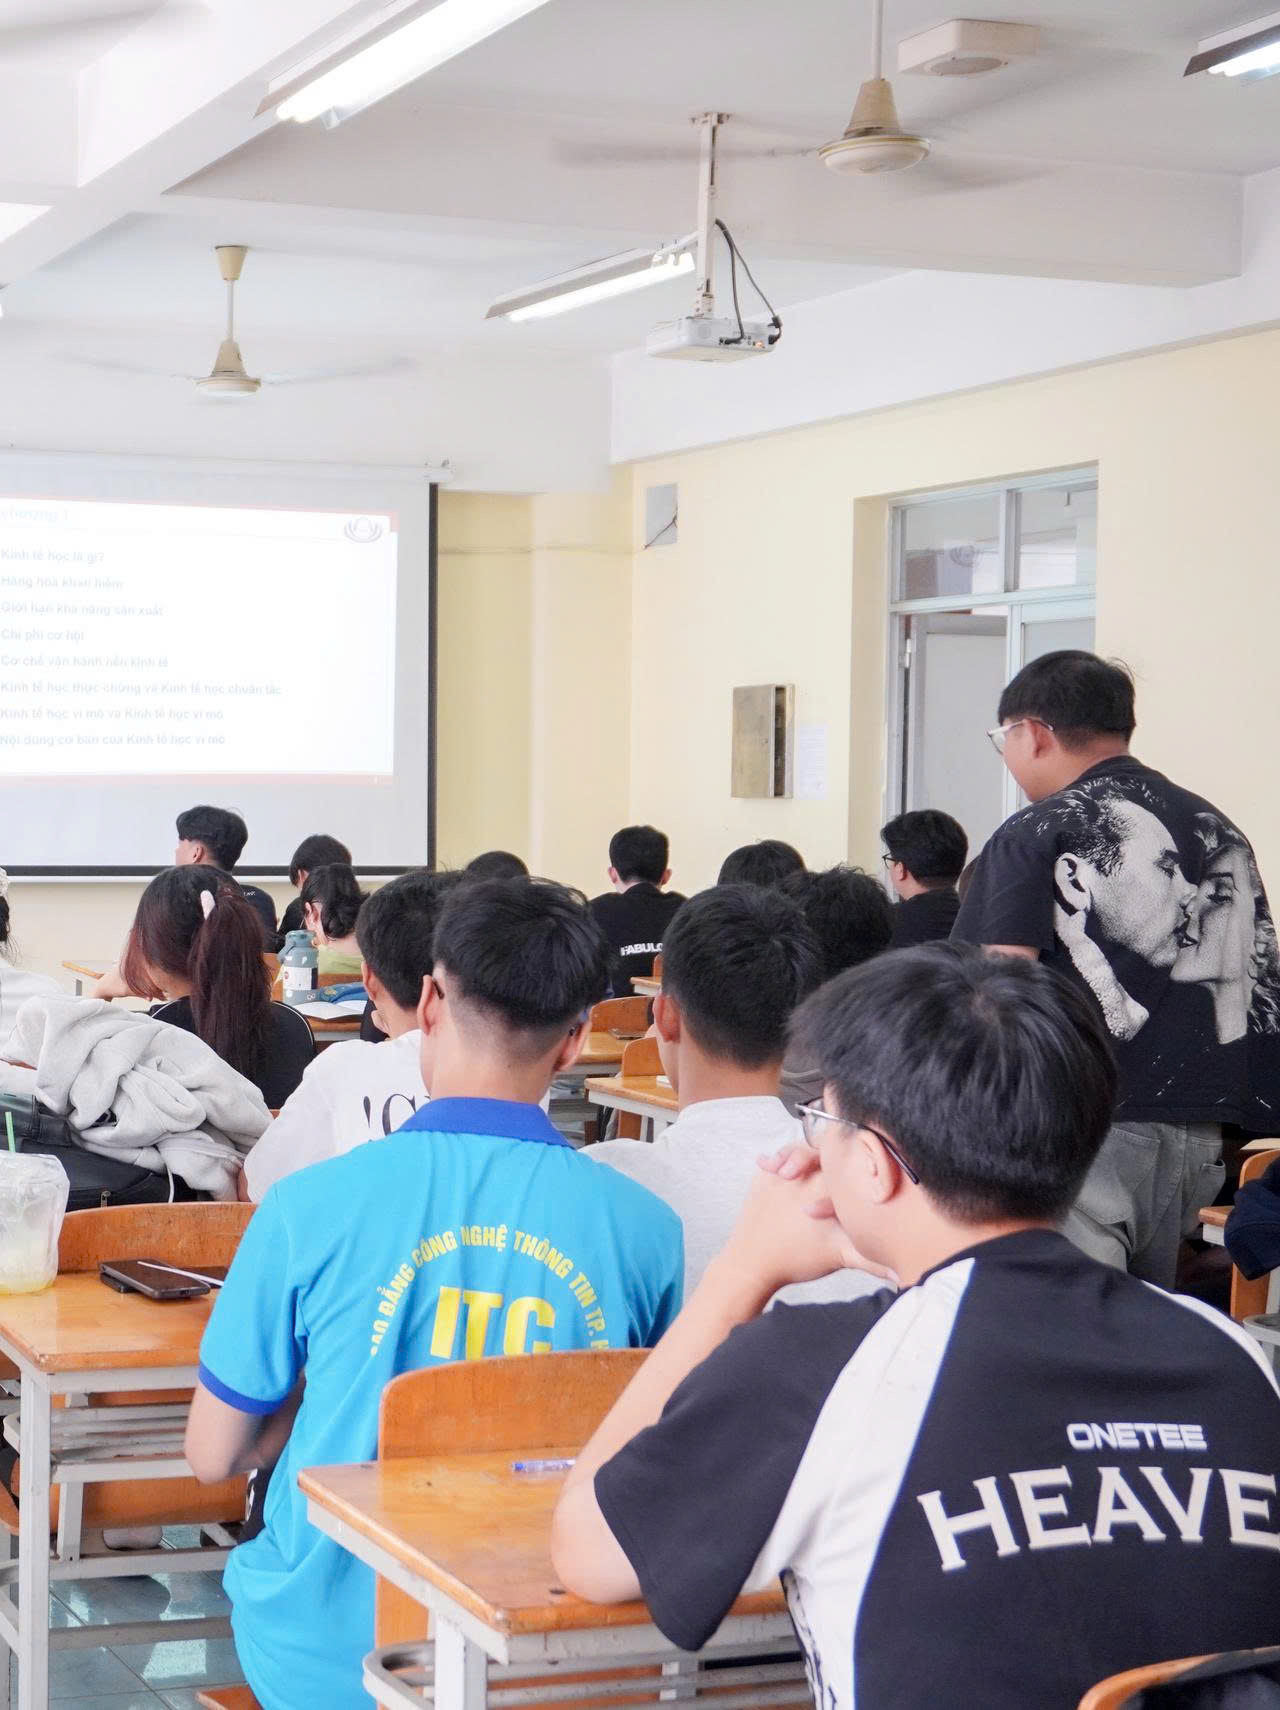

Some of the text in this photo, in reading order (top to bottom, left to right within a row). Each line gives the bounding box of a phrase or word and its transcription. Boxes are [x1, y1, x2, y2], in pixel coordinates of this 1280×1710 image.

[0, 548, 29, 560] Kinh
[0, 707, 29, 720] Kinh
[125, 706, 152, 720] Kinh
[411, 1229, 458, 1268] CÔNG
[460, 1224, 508, 1252] NGHỆ
[513, 1229, 575, 1279] THÔNG
[568, 1271, 598, 1308] TIN
[430, 1285, 556, 1361] ITC
[1066, 1422, 1208, 1451] ONETEE
